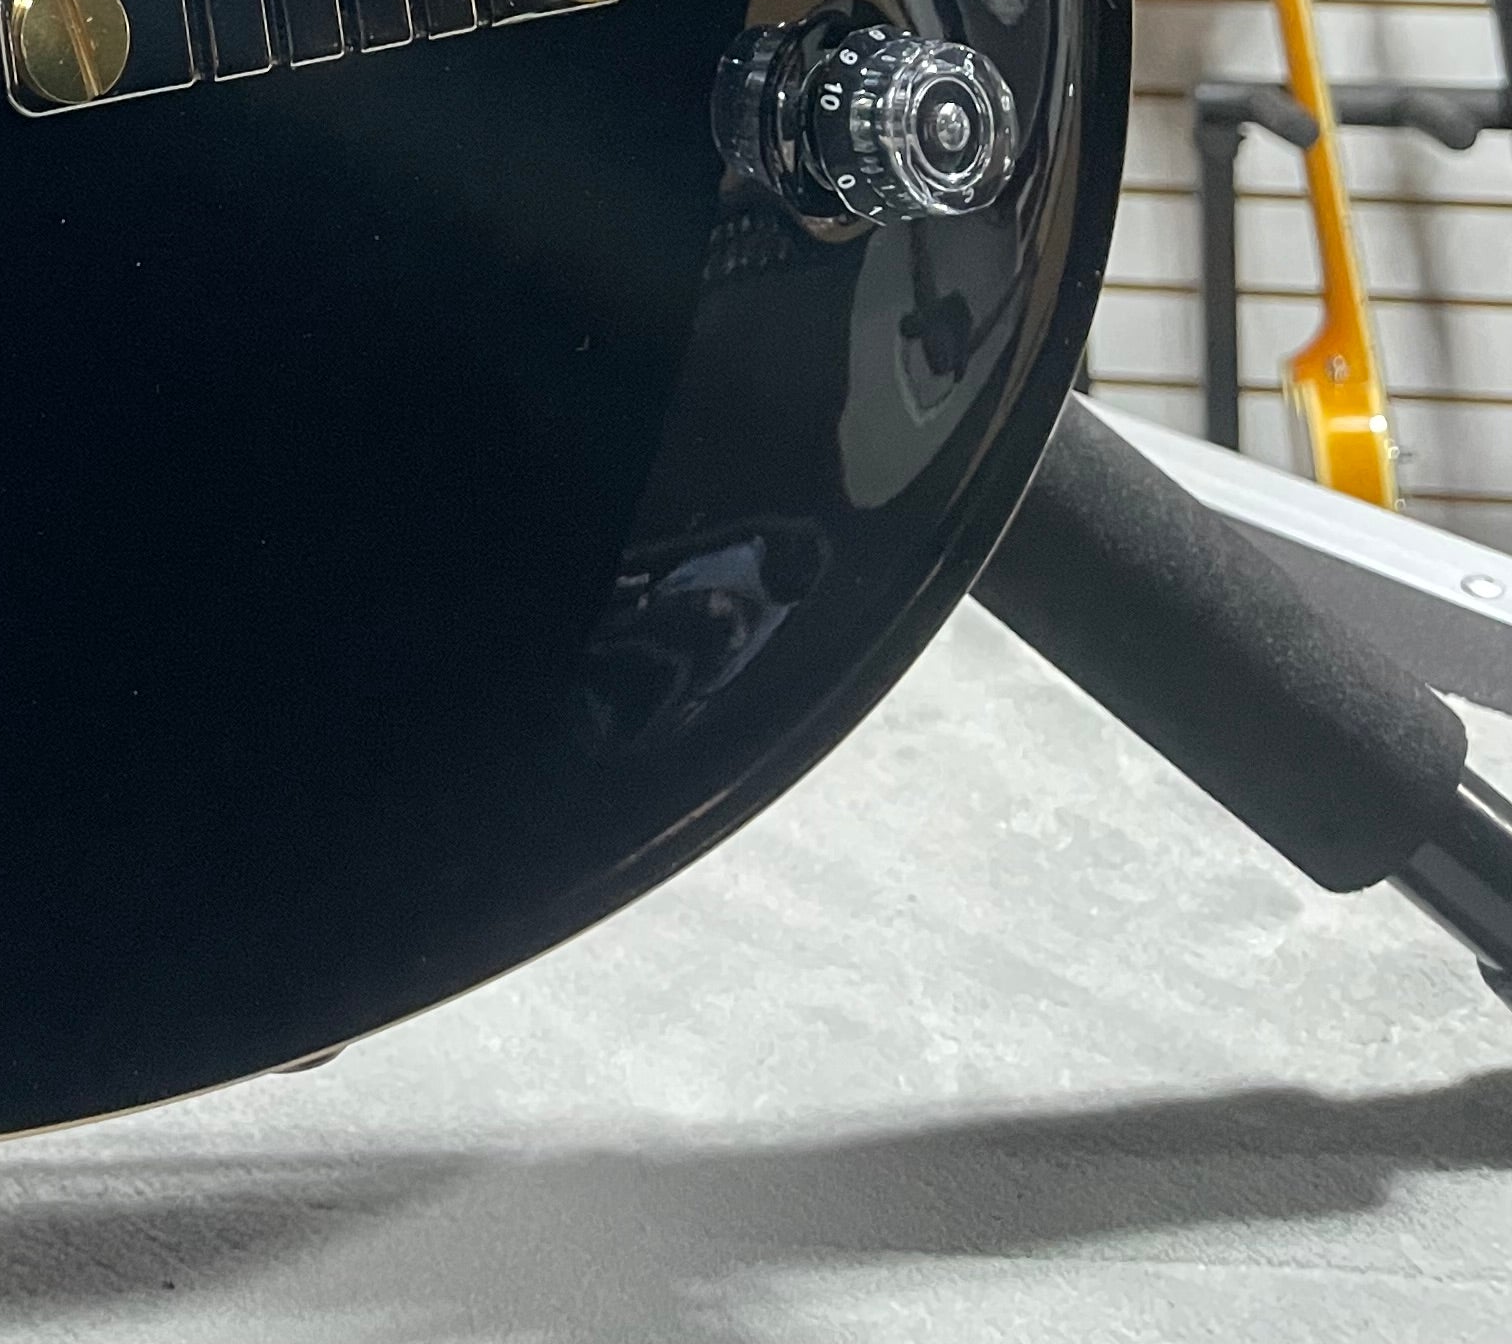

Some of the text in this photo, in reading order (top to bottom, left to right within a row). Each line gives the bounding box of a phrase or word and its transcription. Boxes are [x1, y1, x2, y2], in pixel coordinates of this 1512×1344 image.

[839, 48, 859, 65] 9
[819, 82, 843, 111] 10
[837, 173, 856, 190] 0
